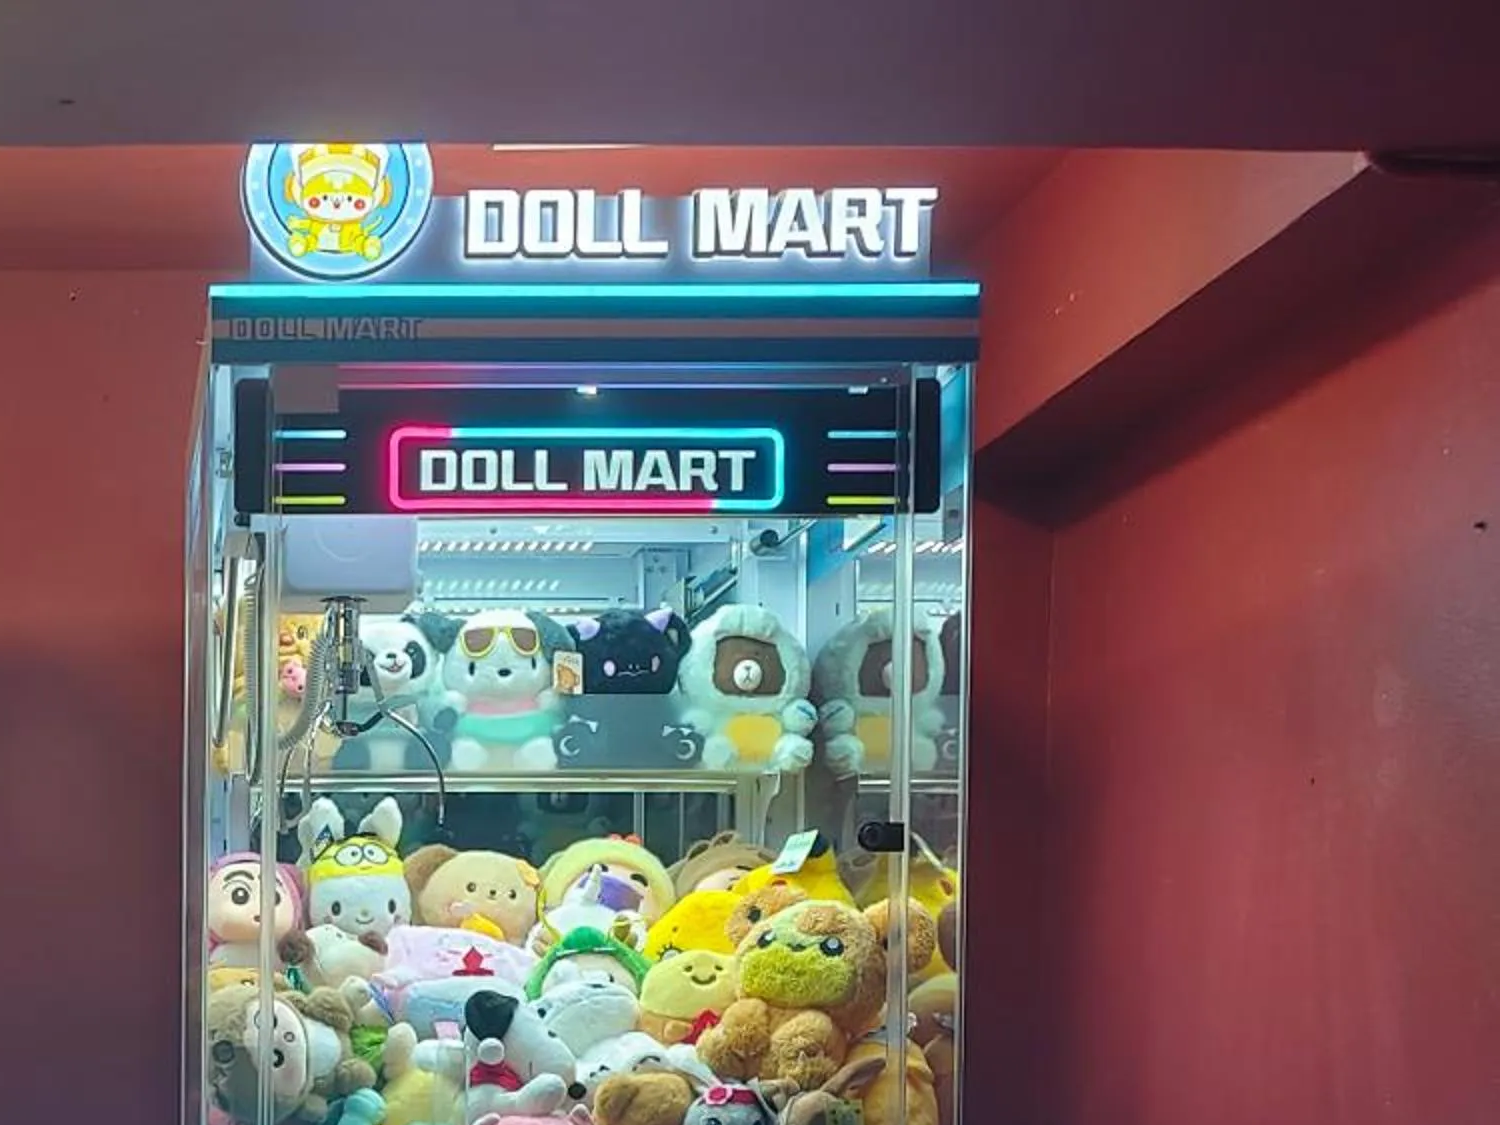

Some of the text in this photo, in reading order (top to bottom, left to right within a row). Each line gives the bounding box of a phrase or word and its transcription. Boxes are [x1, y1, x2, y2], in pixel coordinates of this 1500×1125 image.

[464, 186, 938, 259] DOLL MART
[229, 315, 424, 341] DOLL MART
[419, 449, 756, 493] DOLL MART
